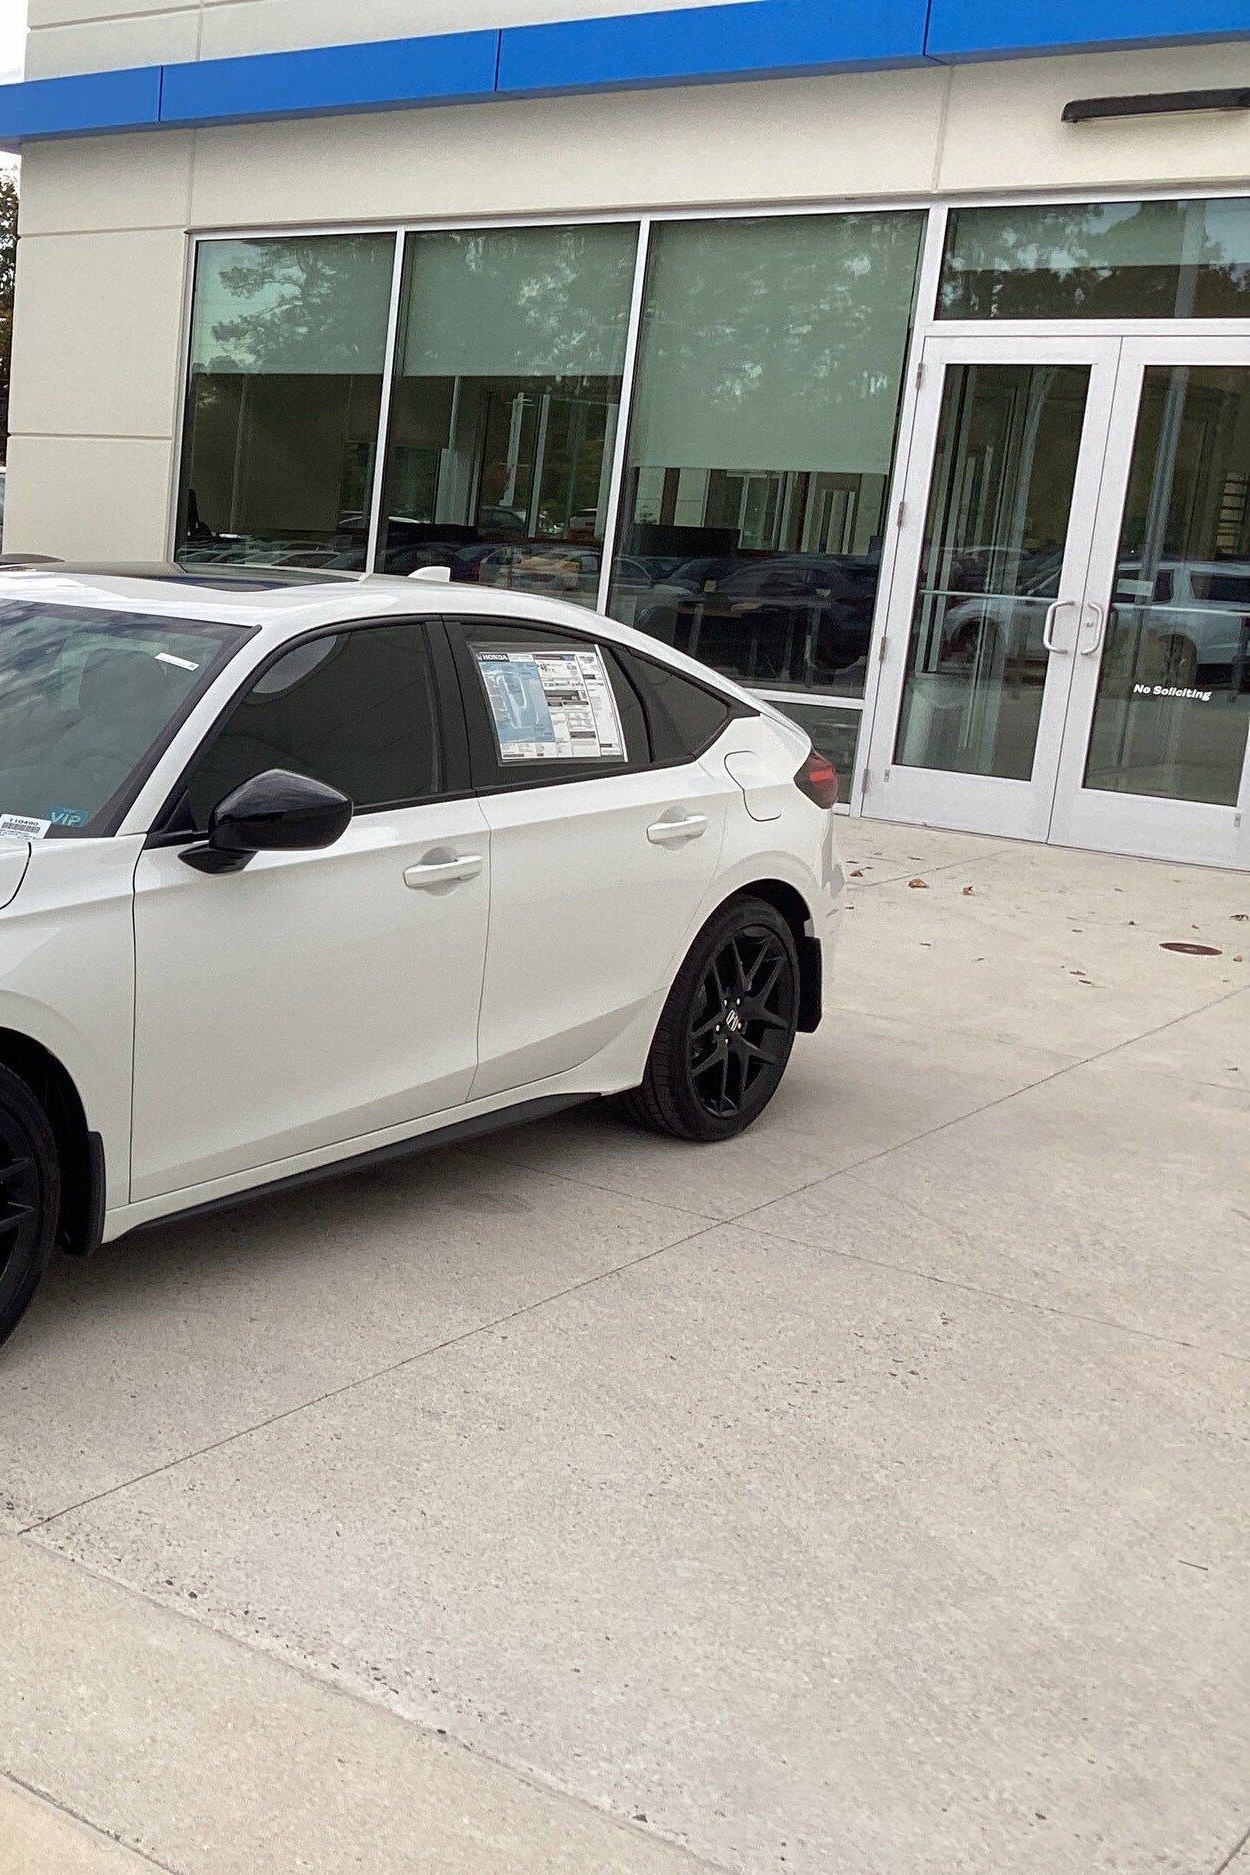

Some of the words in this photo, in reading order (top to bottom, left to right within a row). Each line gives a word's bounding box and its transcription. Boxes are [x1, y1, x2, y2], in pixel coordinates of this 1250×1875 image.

[1133, 684, 1151, 694] No
[1153, 685, 1212, 701] Soliciting
[51, 811, 81, 826] VIP
